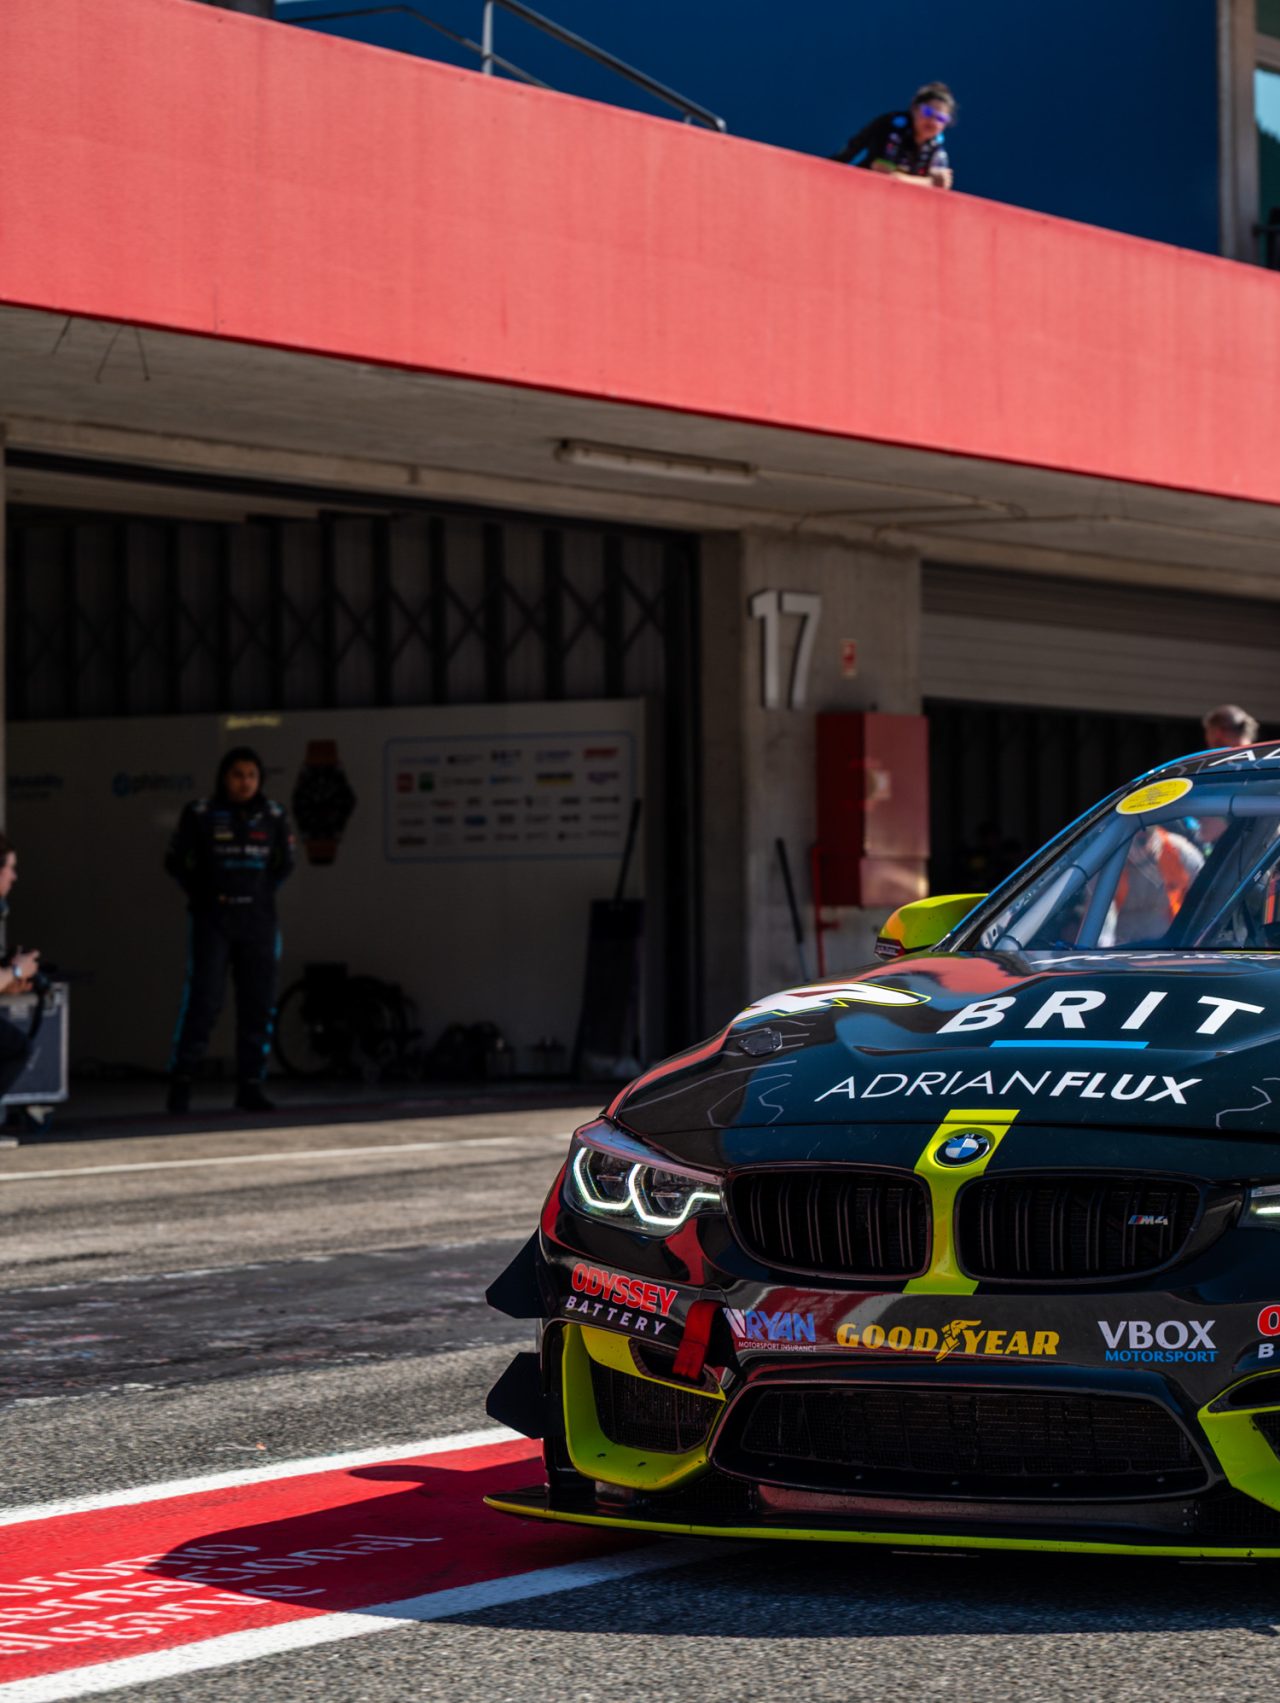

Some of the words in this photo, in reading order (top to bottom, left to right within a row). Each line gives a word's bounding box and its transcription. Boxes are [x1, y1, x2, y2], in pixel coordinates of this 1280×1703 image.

[752, 590, 821, 709] 17
[937, 991, 1265, 1034] BRIT
[571, 1262, 679, 1317] ODYSSEY
[565, 1295, 667, 1336] BATTERY
[746, 1310, 816, 1342] RYAN
[1098, 1320, 1216, 1349] VBOX
[738, 1341, 779, 1350] MOTORSPORT
[780, 1344, 817, 1353] INSURANCE
[836, 1320, 1060, 1361] GOODYEAR
[1105, 1350, 1219, 1363] MOTORSPORT
[0, 1533, 444, 1627] ernacional
